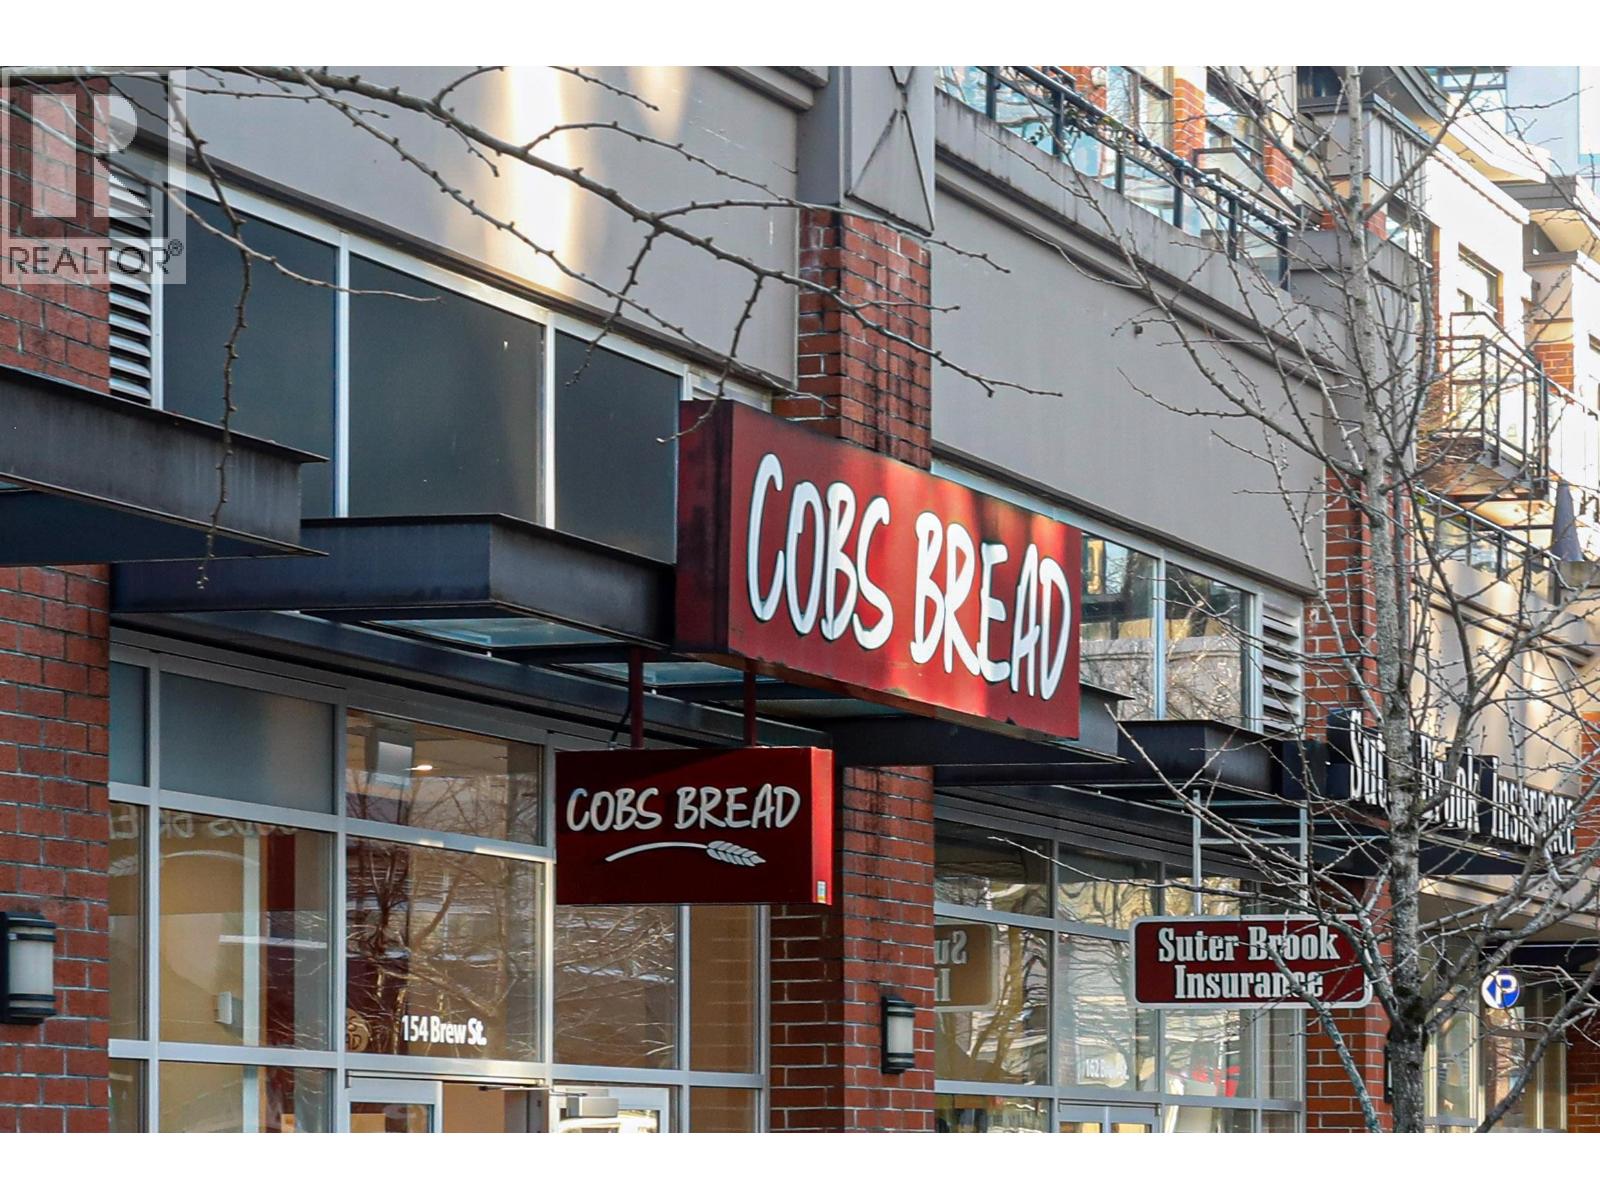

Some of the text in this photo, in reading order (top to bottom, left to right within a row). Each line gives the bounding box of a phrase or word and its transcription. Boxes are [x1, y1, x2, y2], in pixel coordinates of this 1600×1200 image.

[747, 453, 1072, 701] COBS BREAD
[566, 783, 801, 831] COBS BREAD
[1157, 926, 1240, 962] Suter
[401, 1014, 428, 1042] 154
[429, 1016, 467, 1044] Brew
[467, 1017, 487, 1045] St.
